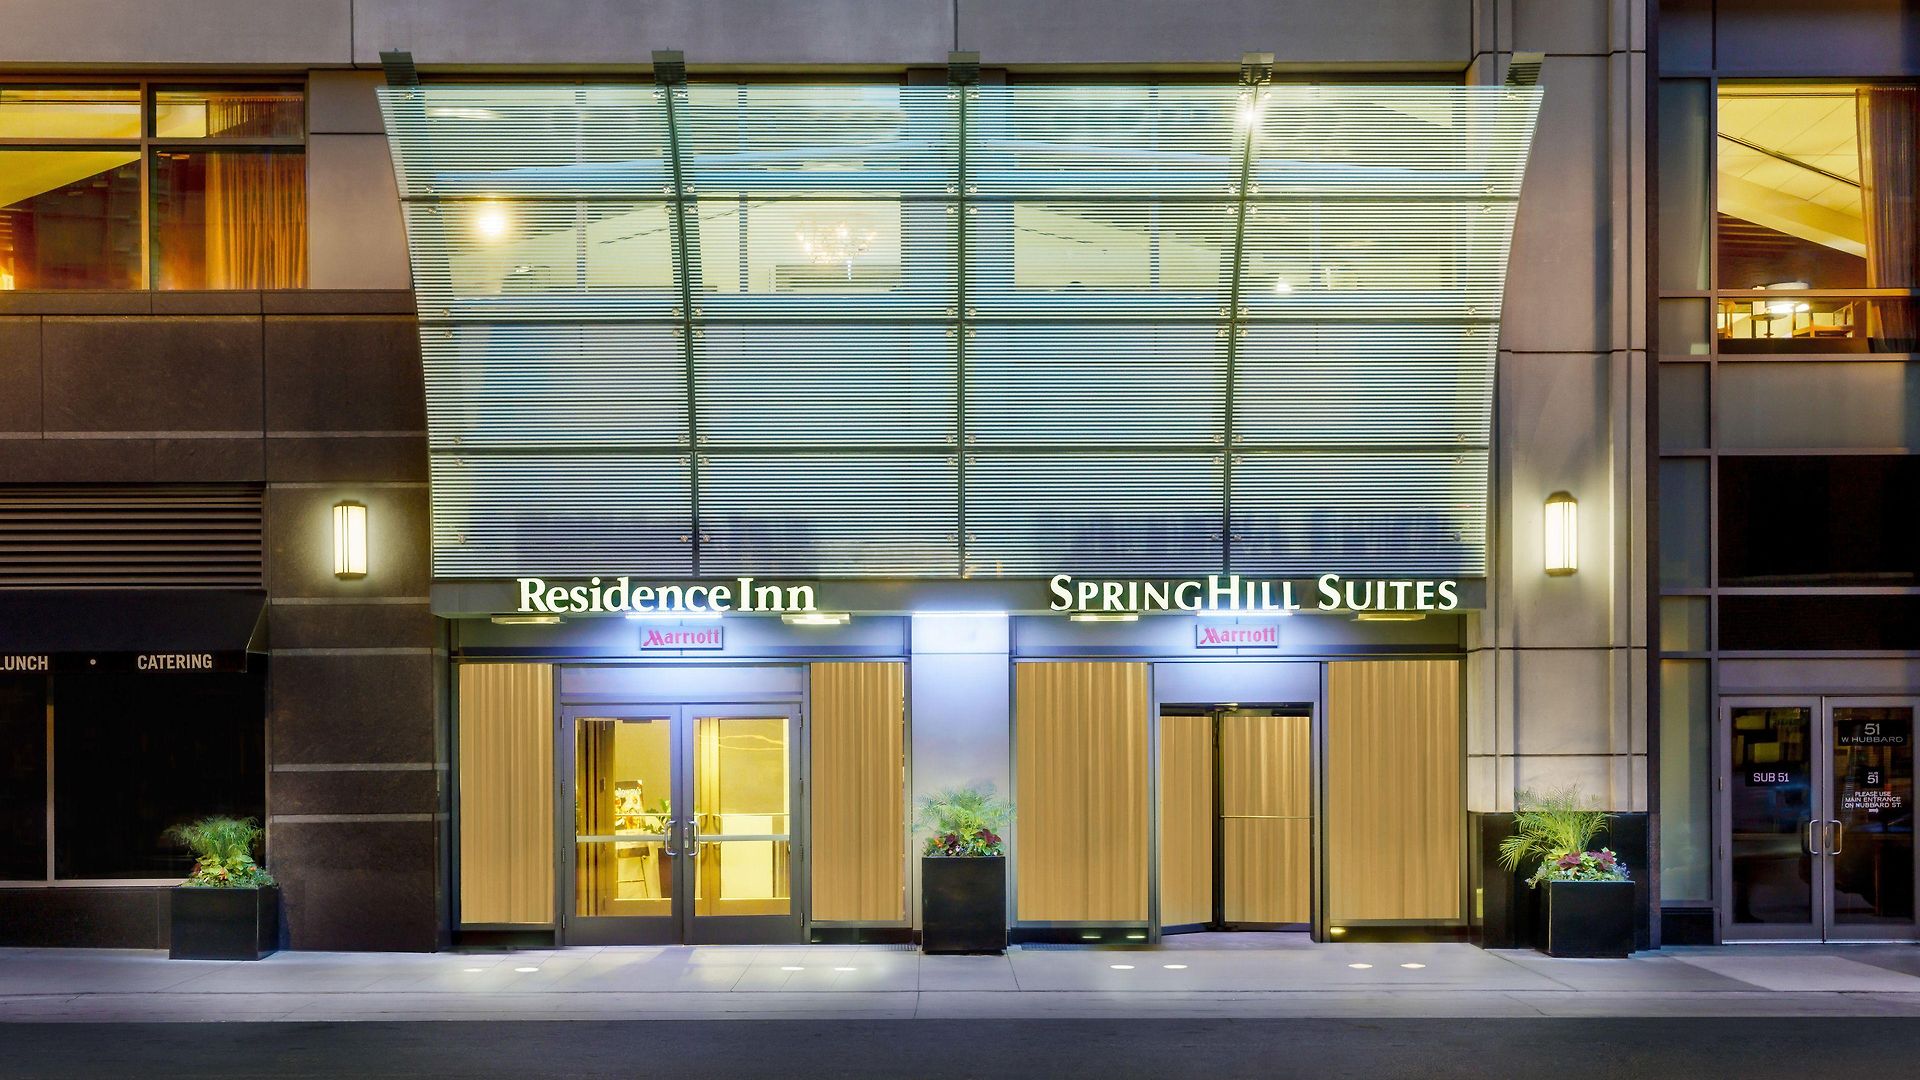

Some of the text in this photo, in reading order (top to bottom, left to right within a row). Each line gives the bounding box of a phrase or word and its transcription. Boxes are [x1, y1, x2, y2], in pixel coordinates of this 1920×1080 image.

[516, 576, 817, 612] Residence Inn
[1317, 573, 1459, 611] SUITES
[643, 629, 720, 646] Marriott
[1200, 627, 1276, 645] Marriott
[137, 654, 213, 670] CATERING
[1864, 723, 1880, 735] 51
[1753, 772, 1789, 782] SUB 51
[1867, 775, 1879, 784] 51
